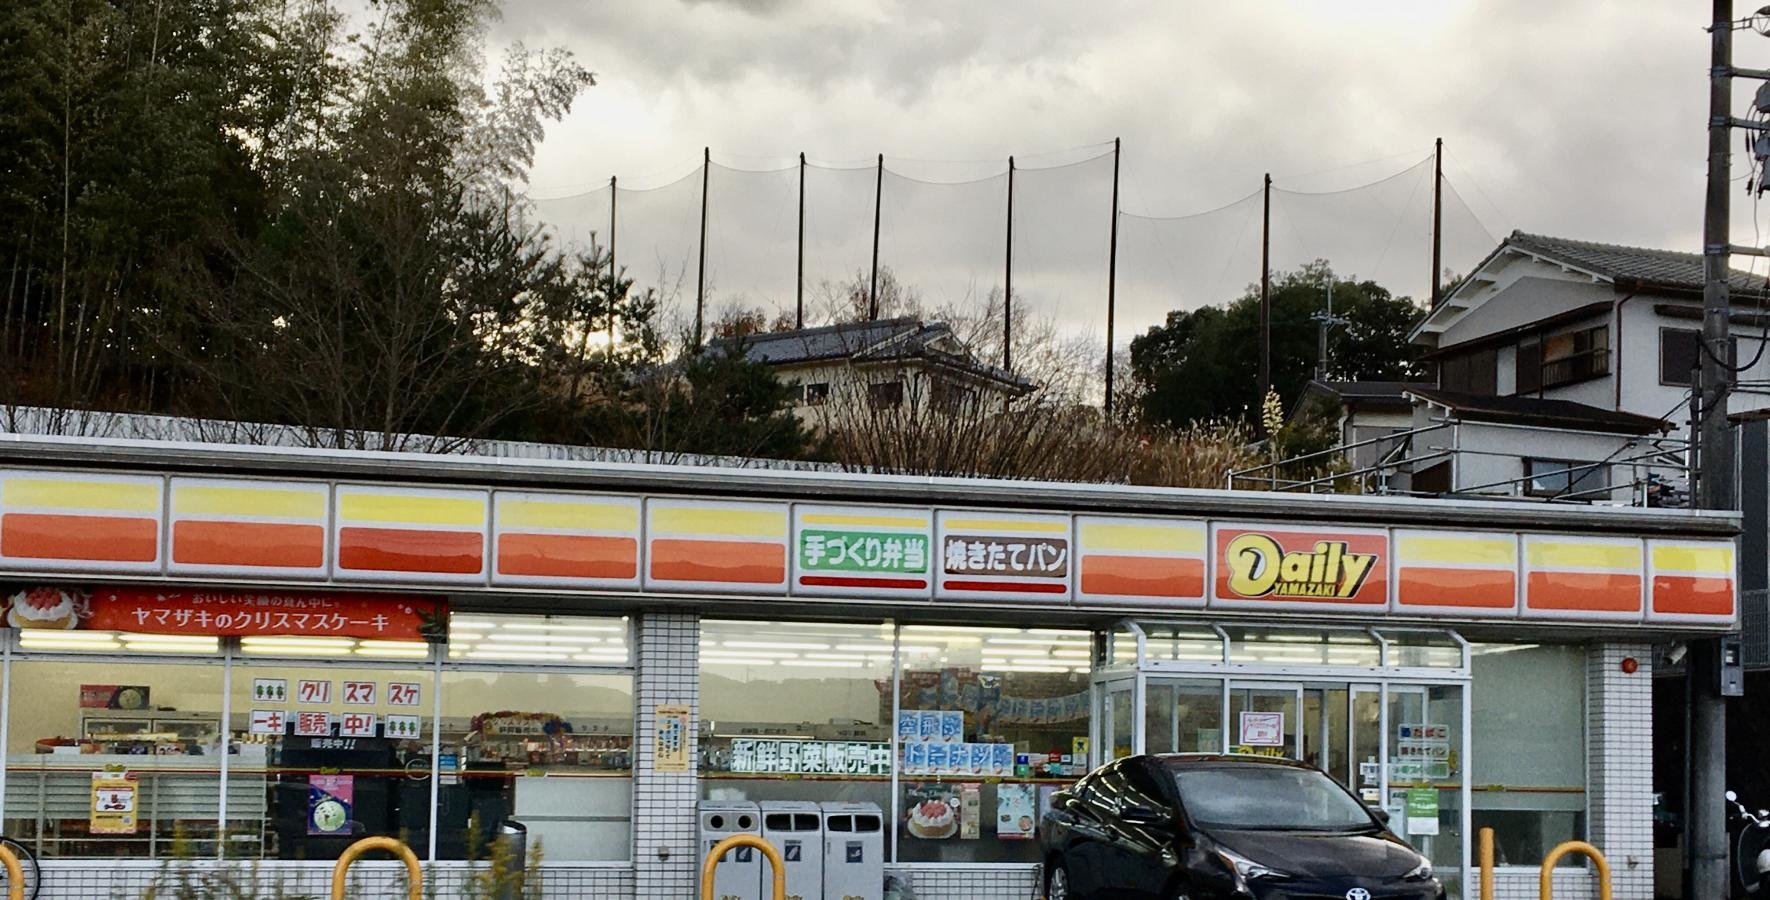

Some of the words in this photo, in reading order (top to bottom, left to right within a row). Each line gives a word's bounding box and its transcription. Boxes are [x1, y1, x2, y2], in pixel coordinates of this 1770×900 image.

[804, 534, 925, 567] 手づくり弁当
[945, 539, 1066, 572] 焼きたてパン
[1228, 533, 1377, 597] Daily
[1274, 582, 1336, 597] YAMAZAKI
[131, 606, 390, 632] ヤマザキのクリスマスケーキ
[900, 715, 962, 737] 空飛ぶ
[733, 741, 891, 775] 新鮮野菜販売中
